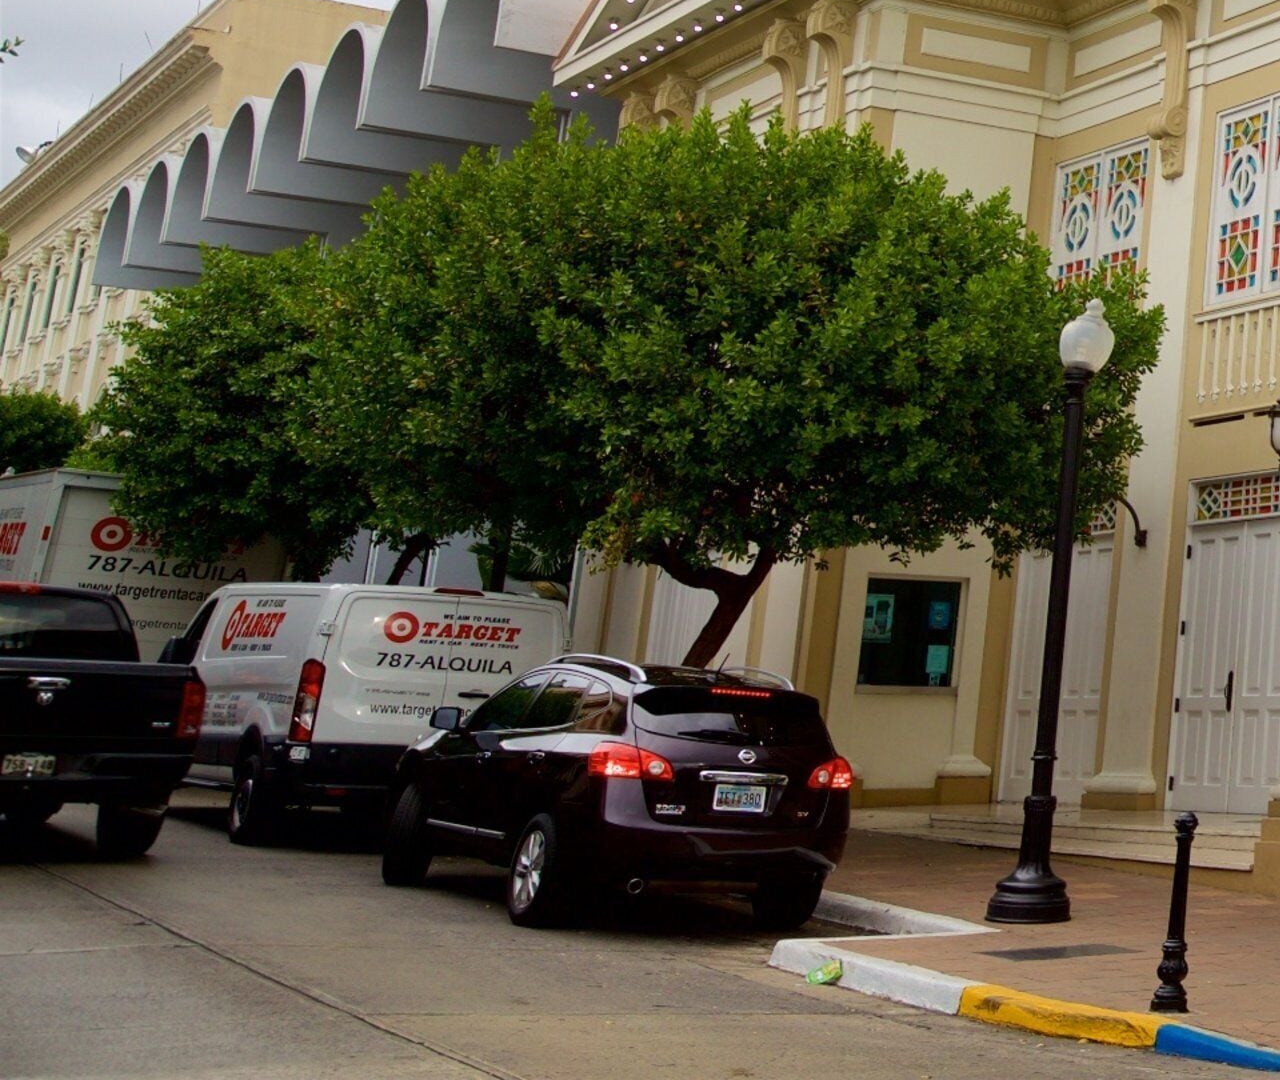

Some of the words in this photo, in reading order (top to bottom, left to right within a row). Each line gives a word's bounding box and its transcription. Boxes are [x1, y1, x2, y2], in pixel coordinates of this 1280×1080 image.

[87, 554, 248, 583] 787-ALQUILA
[422, 622, 521, 642] TARGET
[376, 652, 512, 675] 787-ALQUILA
